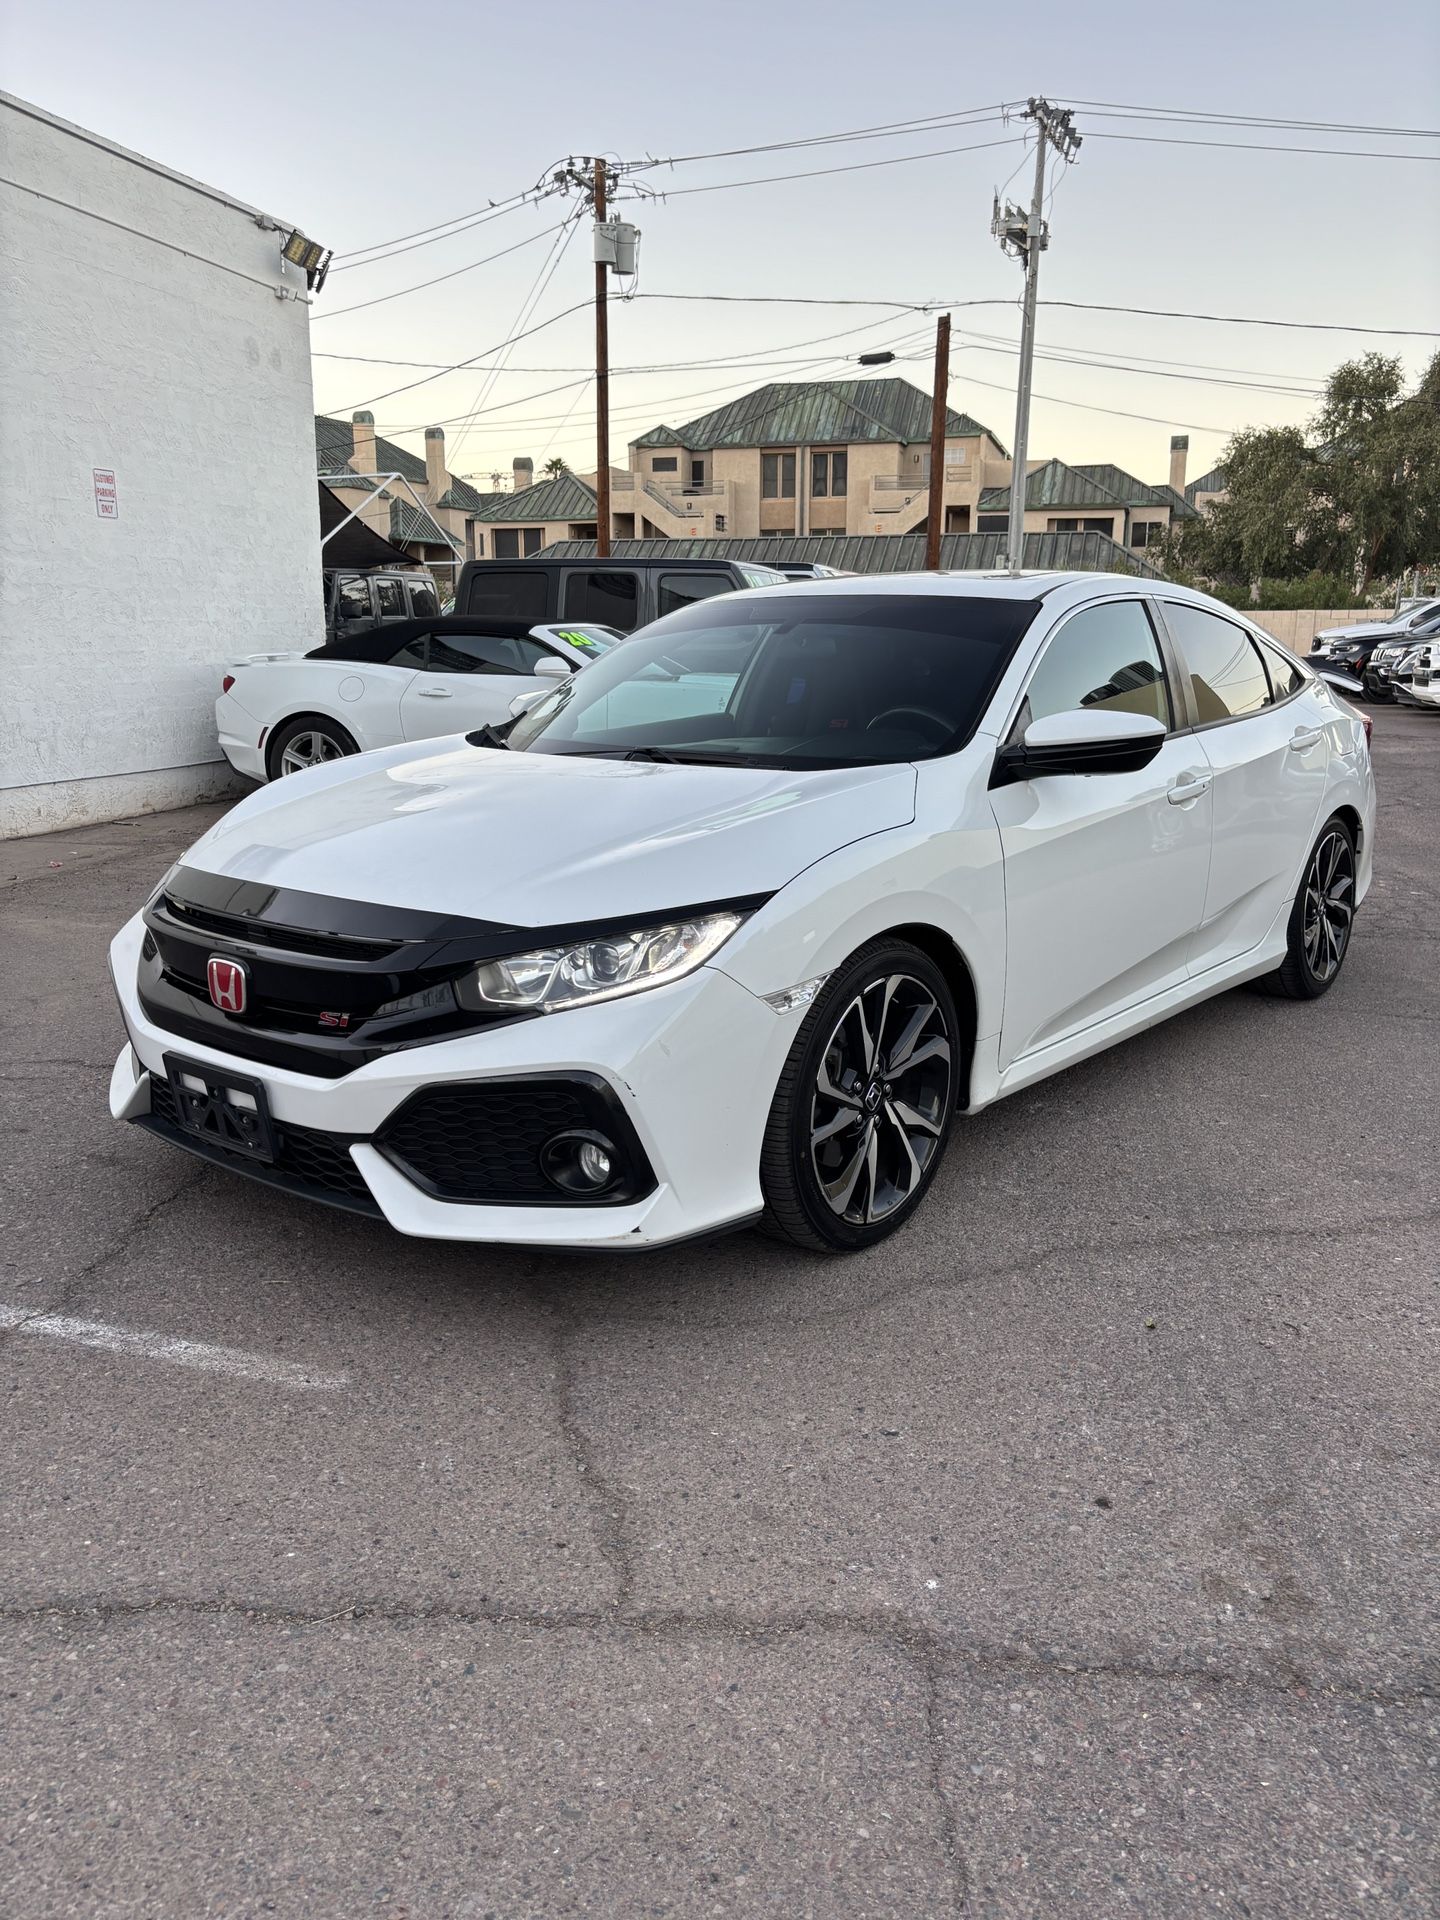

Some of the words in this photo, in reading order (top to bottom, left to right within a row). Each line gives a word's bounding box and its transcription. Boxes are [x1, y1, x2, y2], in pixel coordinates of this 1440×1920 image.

[96, 487, 116, 498] PARKING
[101, 504, 113, 513] ONLY
[558, 631, 593, 646] 20
